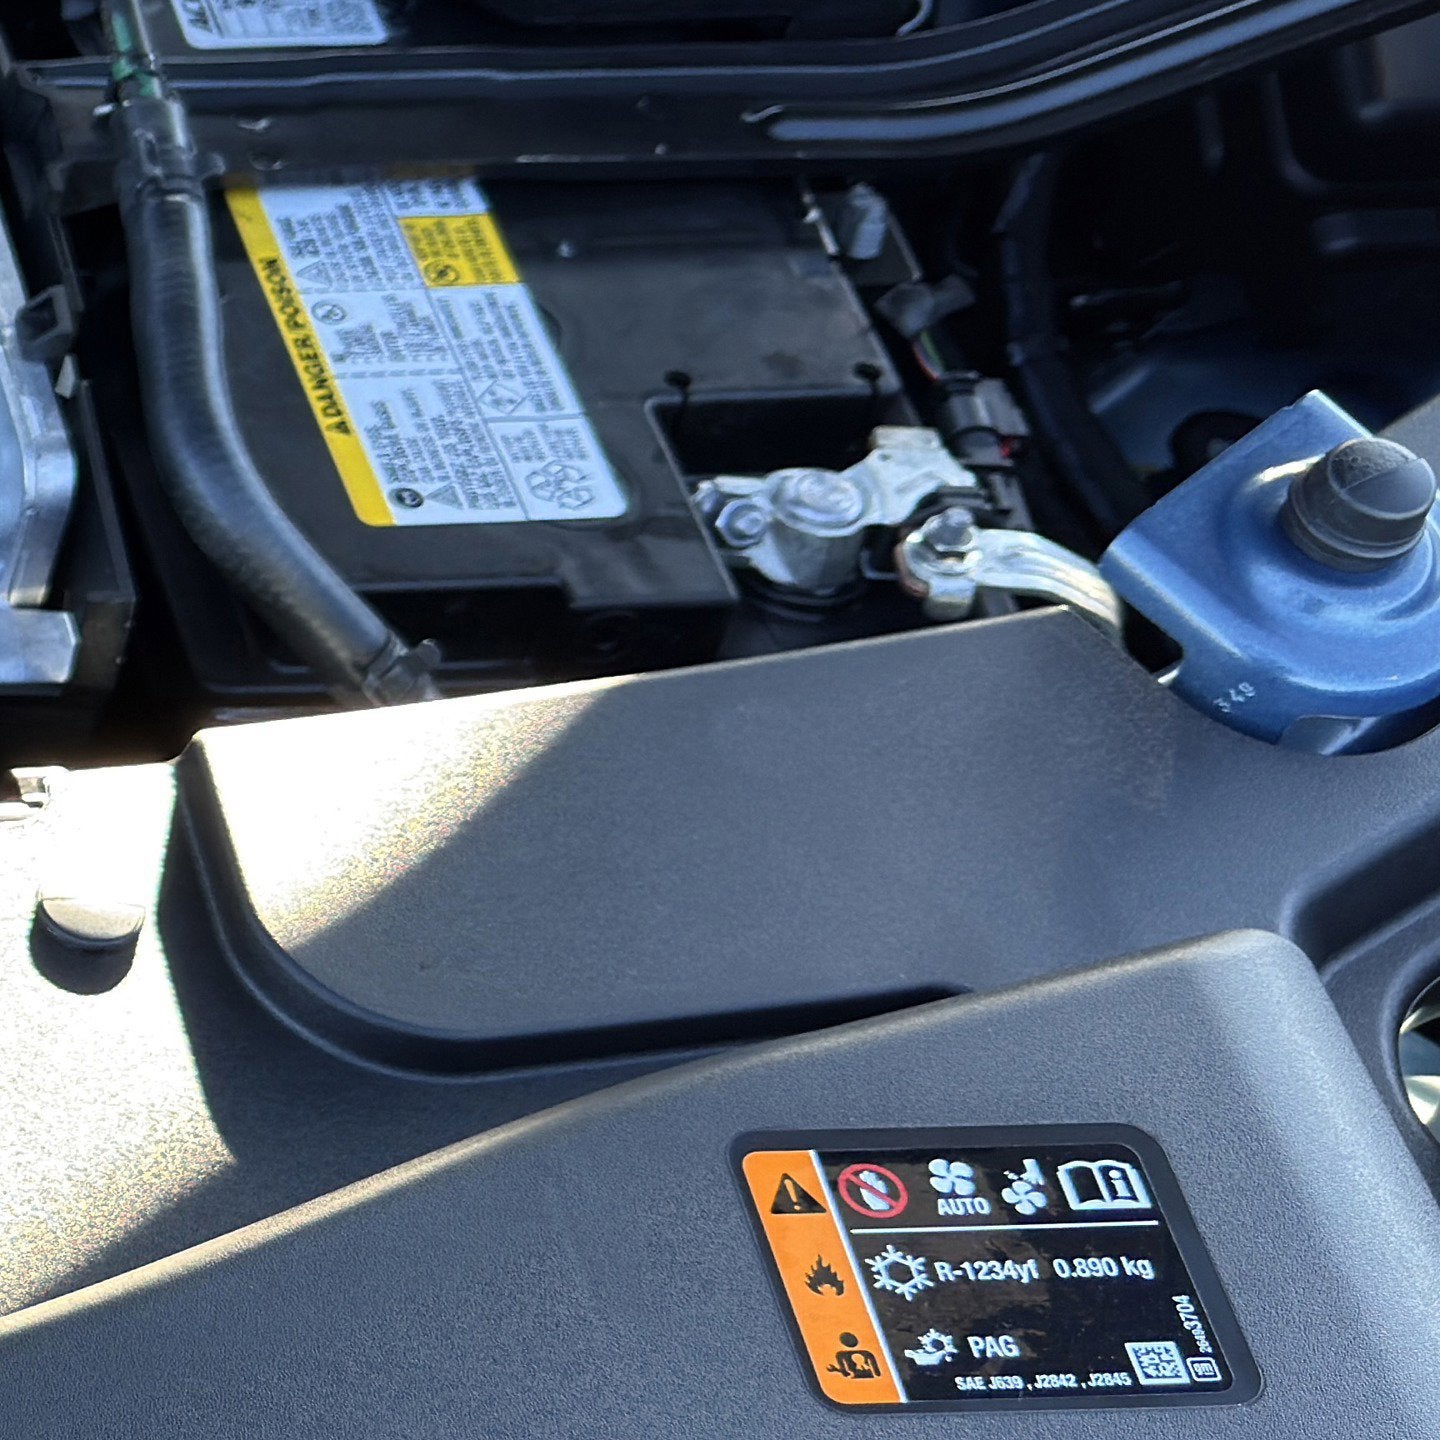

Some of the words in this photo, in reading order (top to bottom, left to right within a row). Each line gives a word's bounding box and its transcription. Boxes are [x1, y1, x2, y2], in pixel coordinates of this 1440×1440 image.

[293, 333, 342, 419] DANGER
[936, 1197, 992, 1216] AUTO
[933, 1259, 1039, 1283] R-1234yf
[1052, 1257, 1119, 1279] 0.890
[1122, 1255, 1155, 1280] kg
[966, 1334, 1022, 1359] PAG
[954, 1376, 986, 1391] SAE
[988, 1375, 1024, 1391] J639
